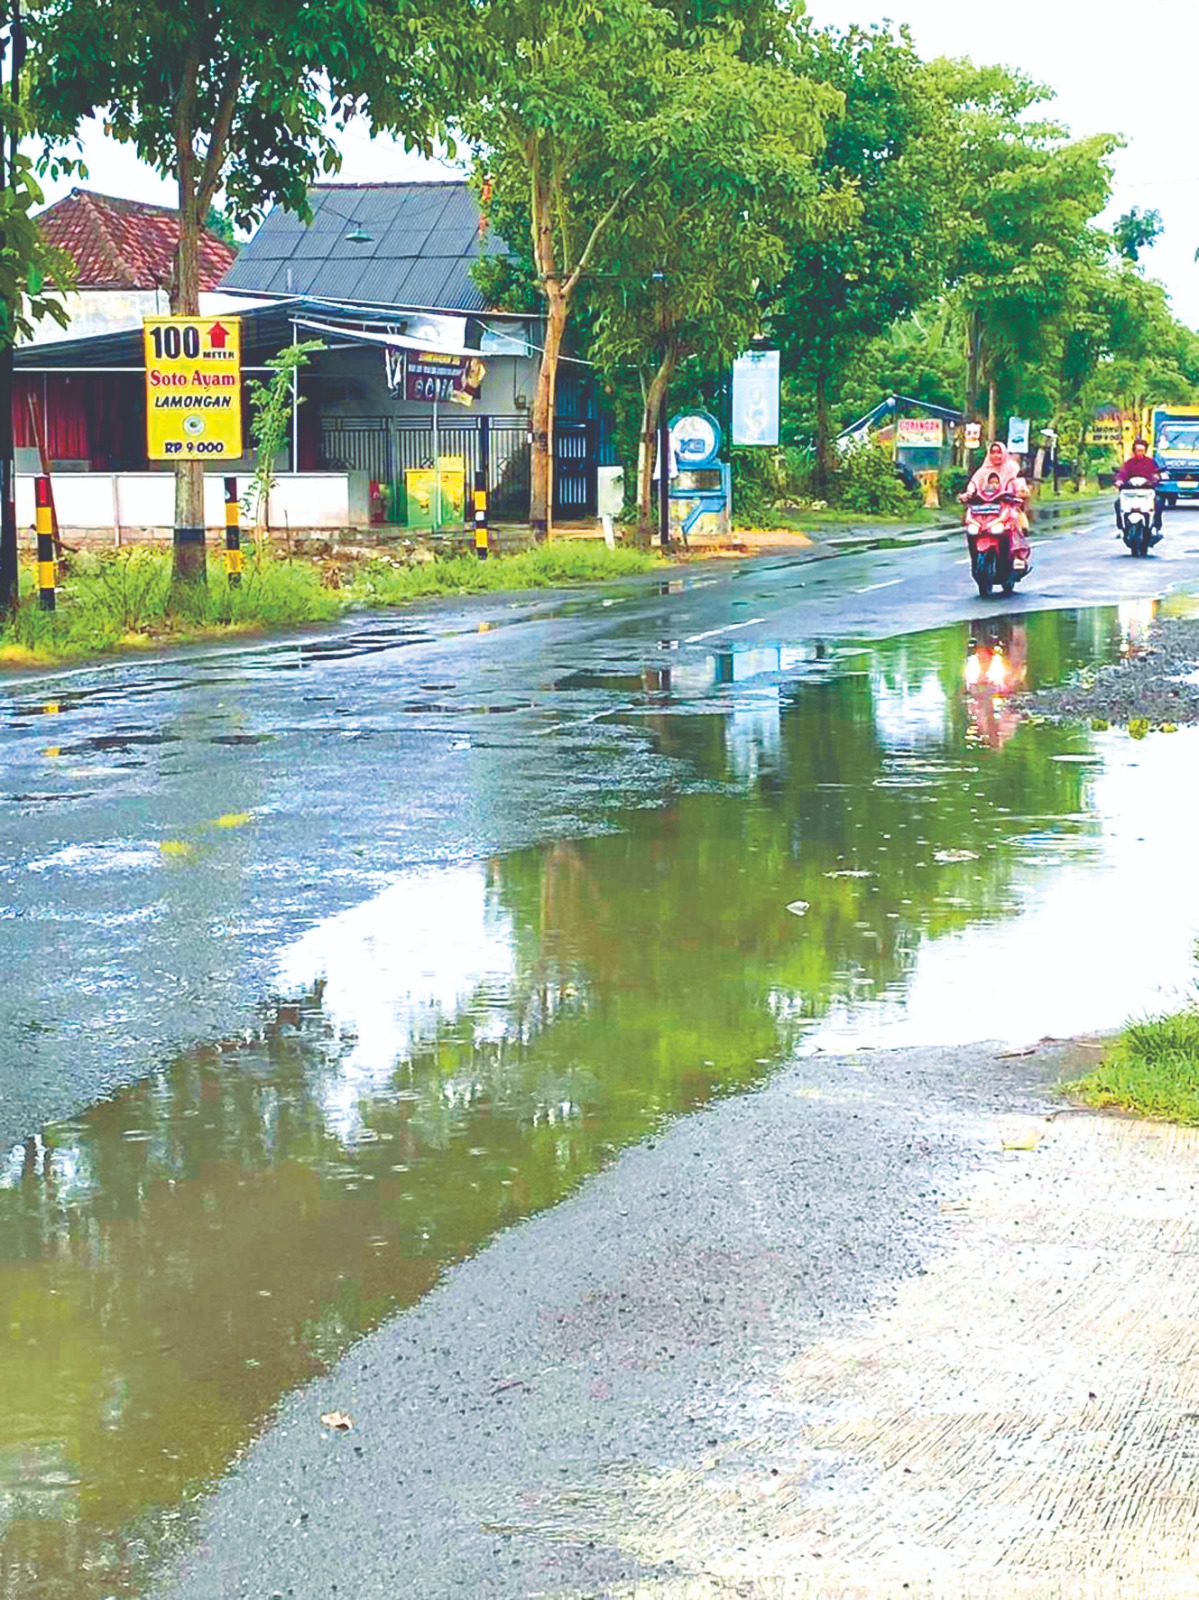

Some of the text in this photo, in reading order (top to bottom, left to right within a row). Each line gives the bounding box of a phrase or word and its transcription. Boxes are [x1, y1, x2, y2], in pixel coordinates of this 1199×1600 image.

[150, 326, 234, 359] 100 METER
[150, 370, 235, 388] Soto Ayam
[155, 396, 231, 408] LAMONGAN
[165, 442, 182, 453] RP
